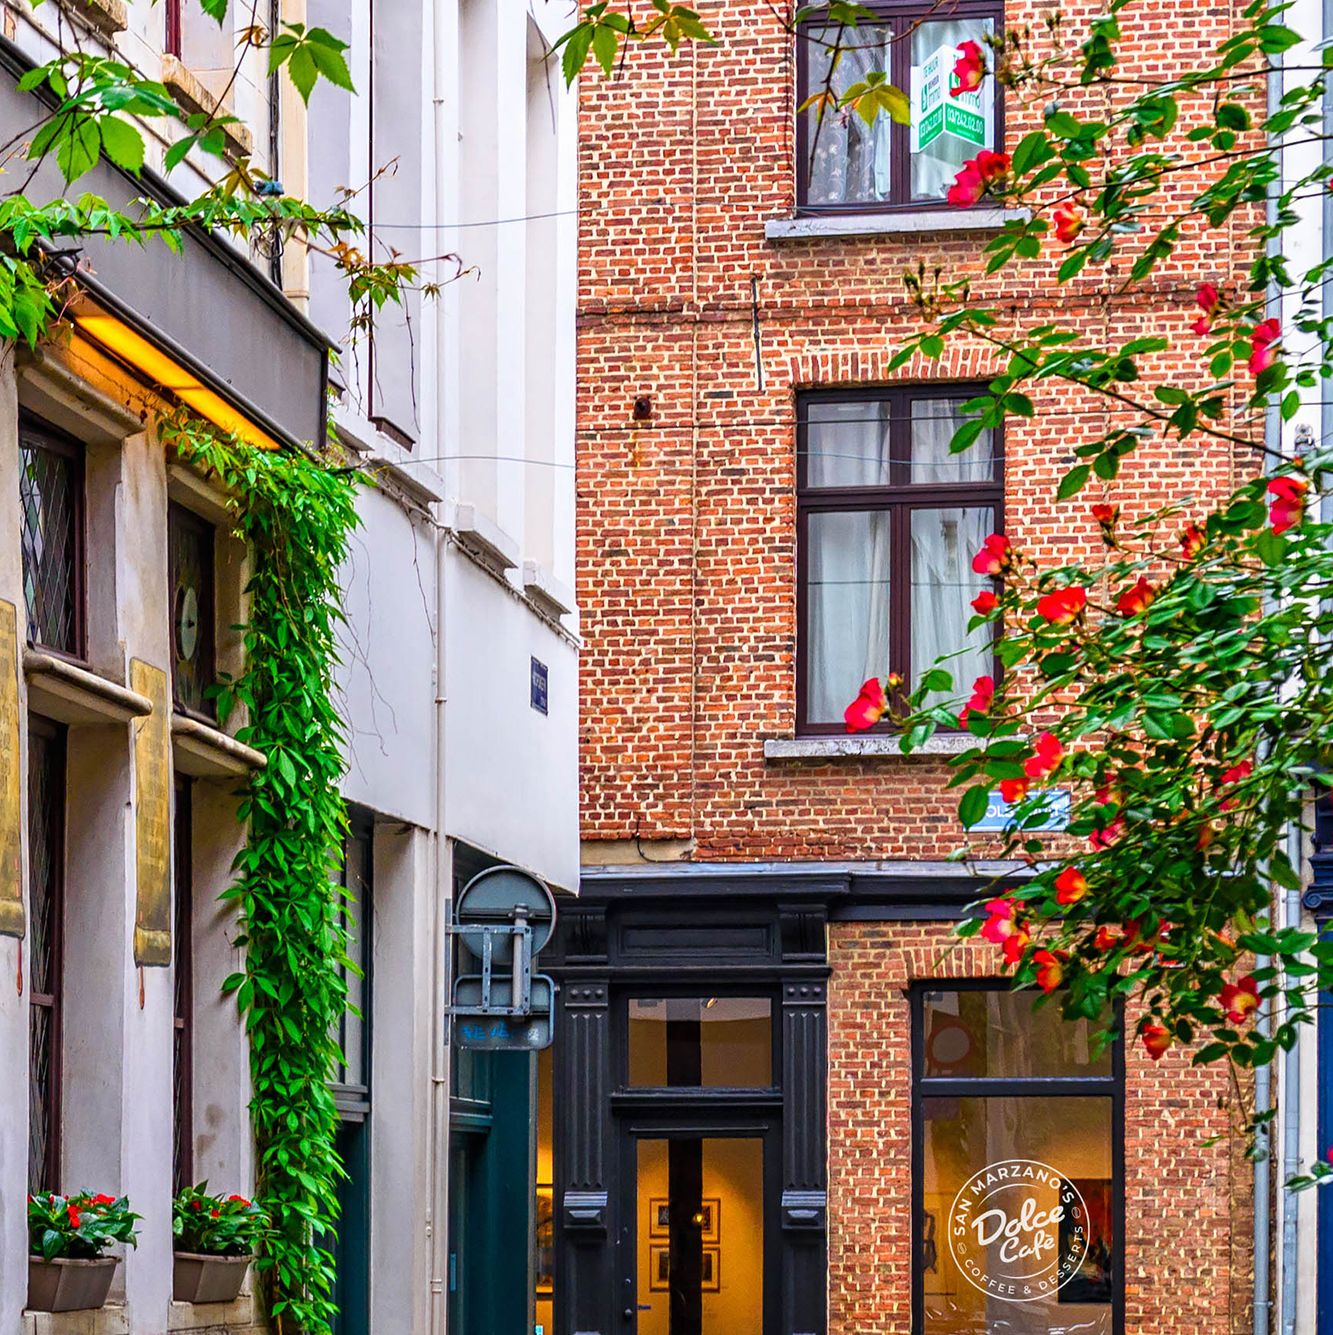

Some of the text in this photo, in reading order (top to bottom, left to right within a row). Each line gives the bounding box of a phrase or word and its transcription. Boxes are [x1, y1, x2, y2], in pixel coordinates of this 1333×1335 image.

[954, 1166, 1074, 1236] SAN MARZANO'S
[971, 1198, 1065, 1246] Dolce
[965, 1226, 1083, 1294] COFFEE & DESSERTS
